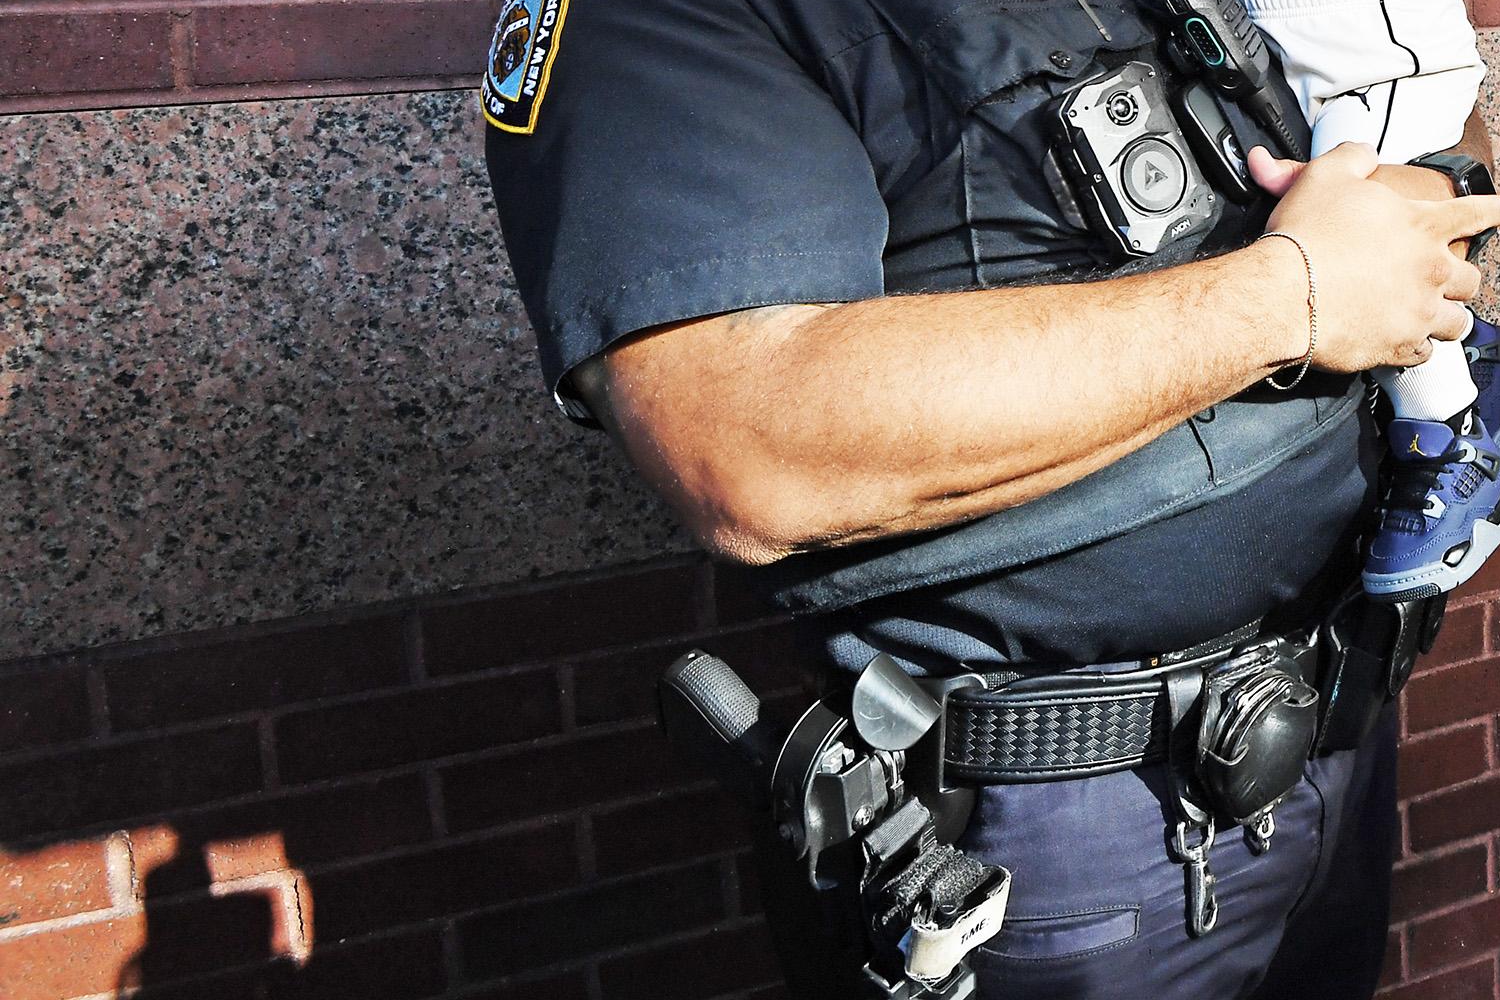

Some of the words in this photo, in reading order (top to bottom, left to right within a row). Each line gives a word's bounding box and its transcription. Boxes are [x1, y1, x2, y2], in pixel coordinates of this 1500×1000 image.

[523, 46, 546, 97] NEW
[490, 96, 506, 115] OF
[1171, 218, 1191, 238] AXON
